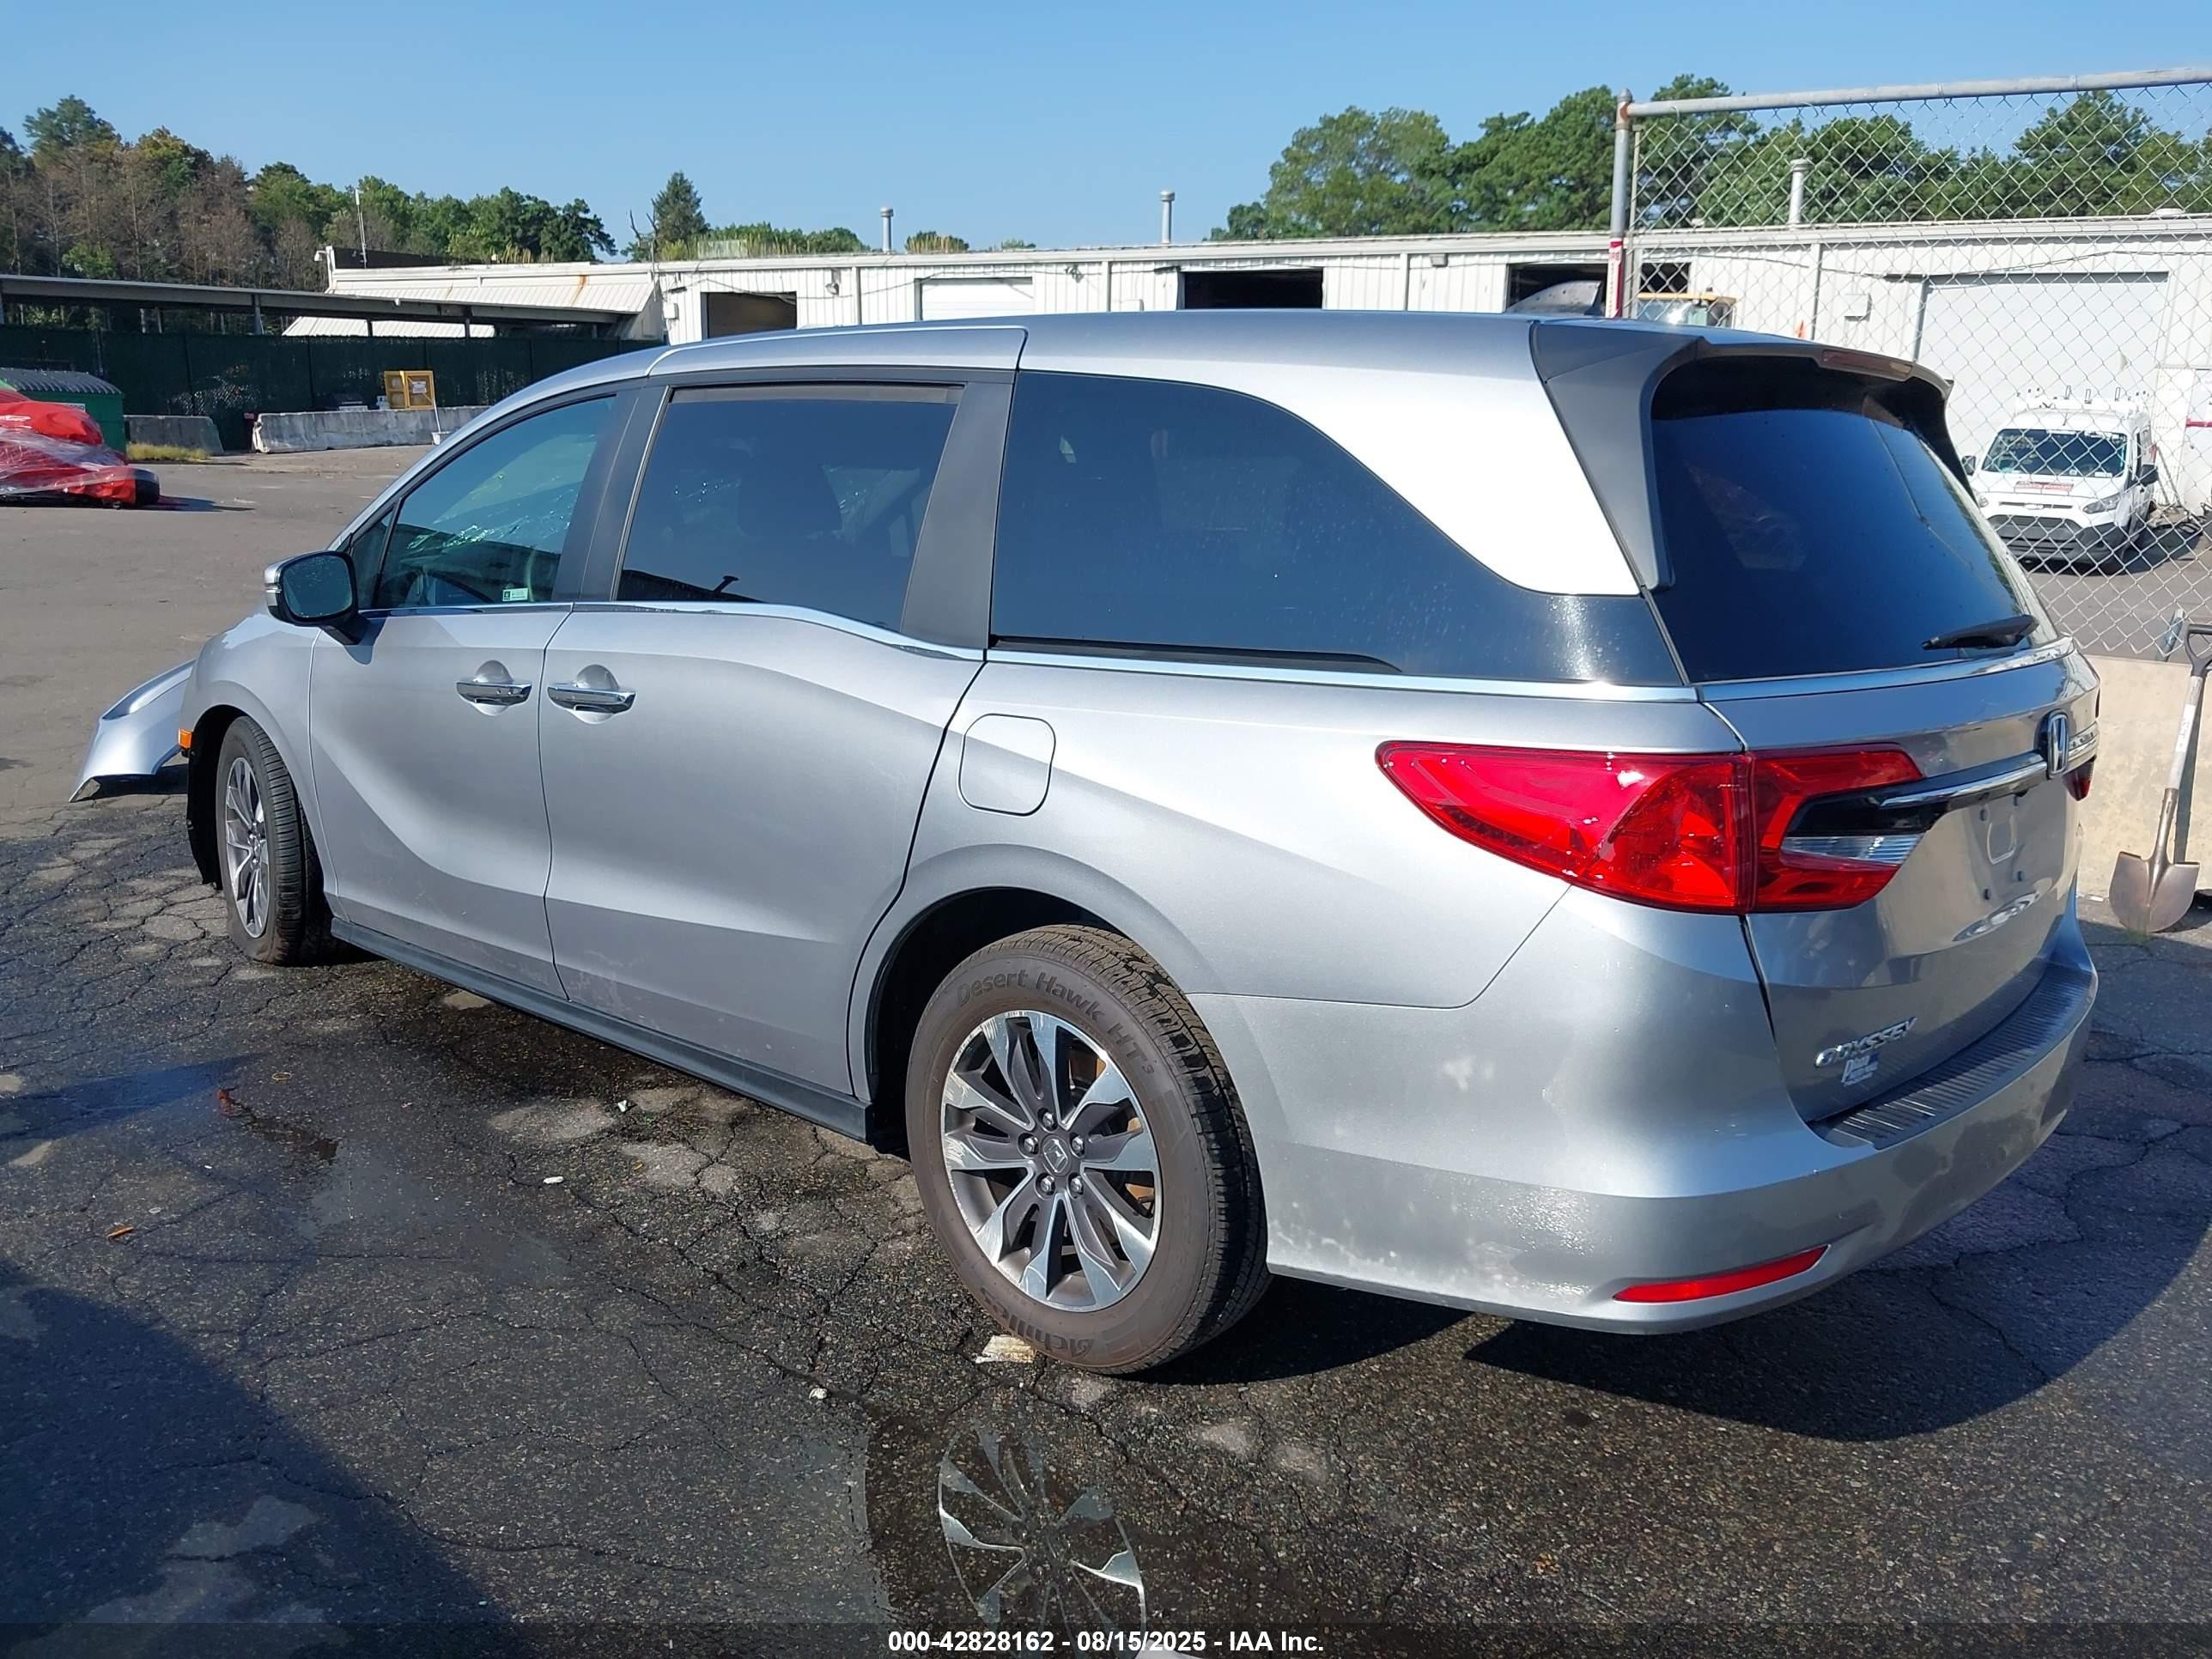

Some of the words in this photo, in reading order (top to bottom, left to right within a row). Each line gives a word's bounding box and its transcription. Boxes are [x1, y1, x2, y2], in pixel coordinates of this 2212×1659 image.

[957, 969, 1029, 1007] Desert
[1036, 971, 1106, 1023] Hawk
[1814, 1017, 1917, 1068] ODYSSEY
